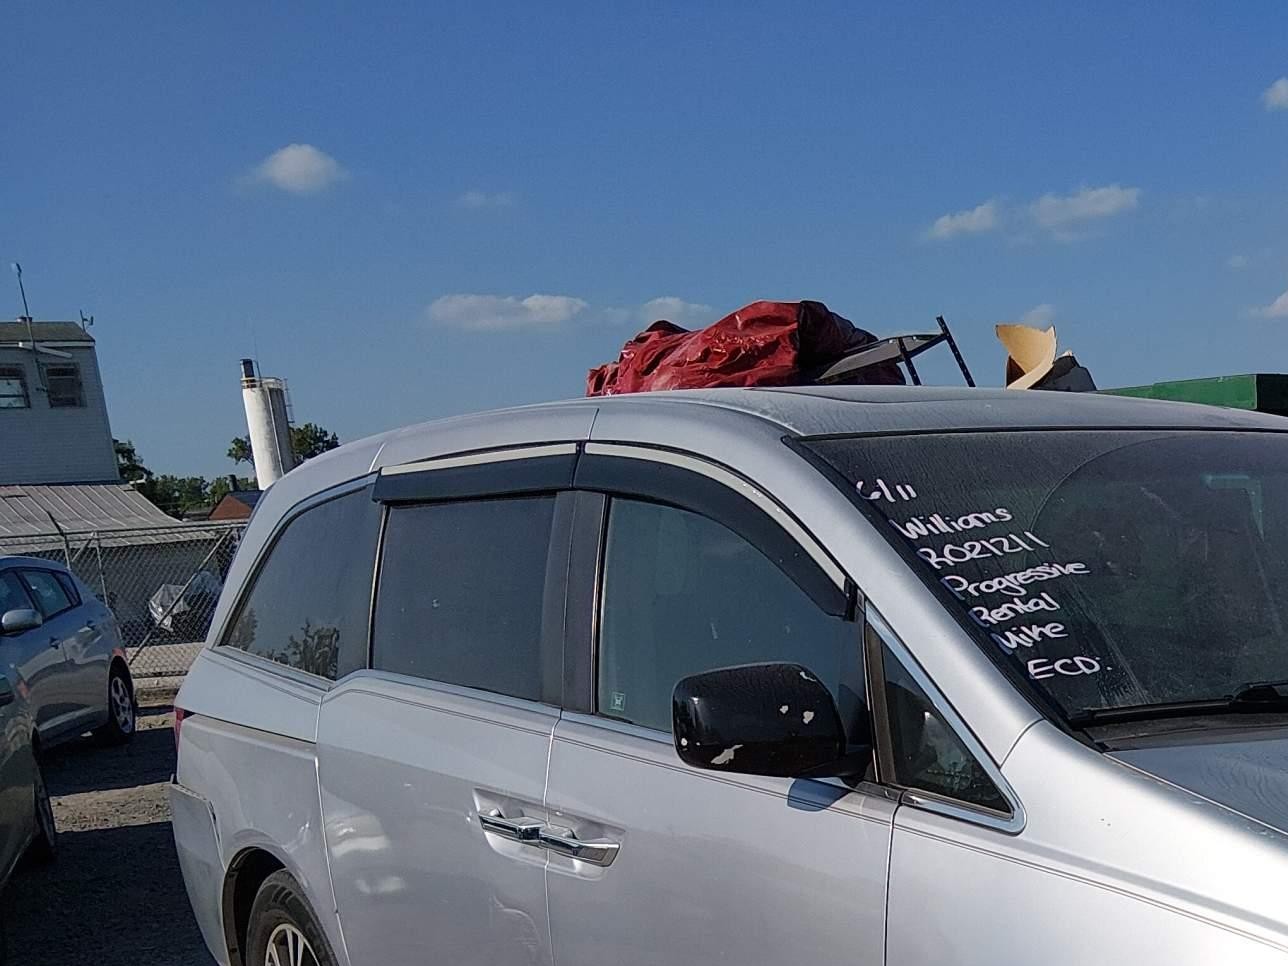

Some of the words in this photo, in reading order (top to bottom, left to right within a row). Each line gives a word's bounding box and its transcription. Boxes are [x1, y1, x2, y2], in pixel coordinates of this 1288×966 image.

[888, 507, 1013, 540] Williams
[940, 562, 1091, 600] Progressive
[968, 592, 1061, 628] Rental
[991, 622, 1069, 656] Mike
